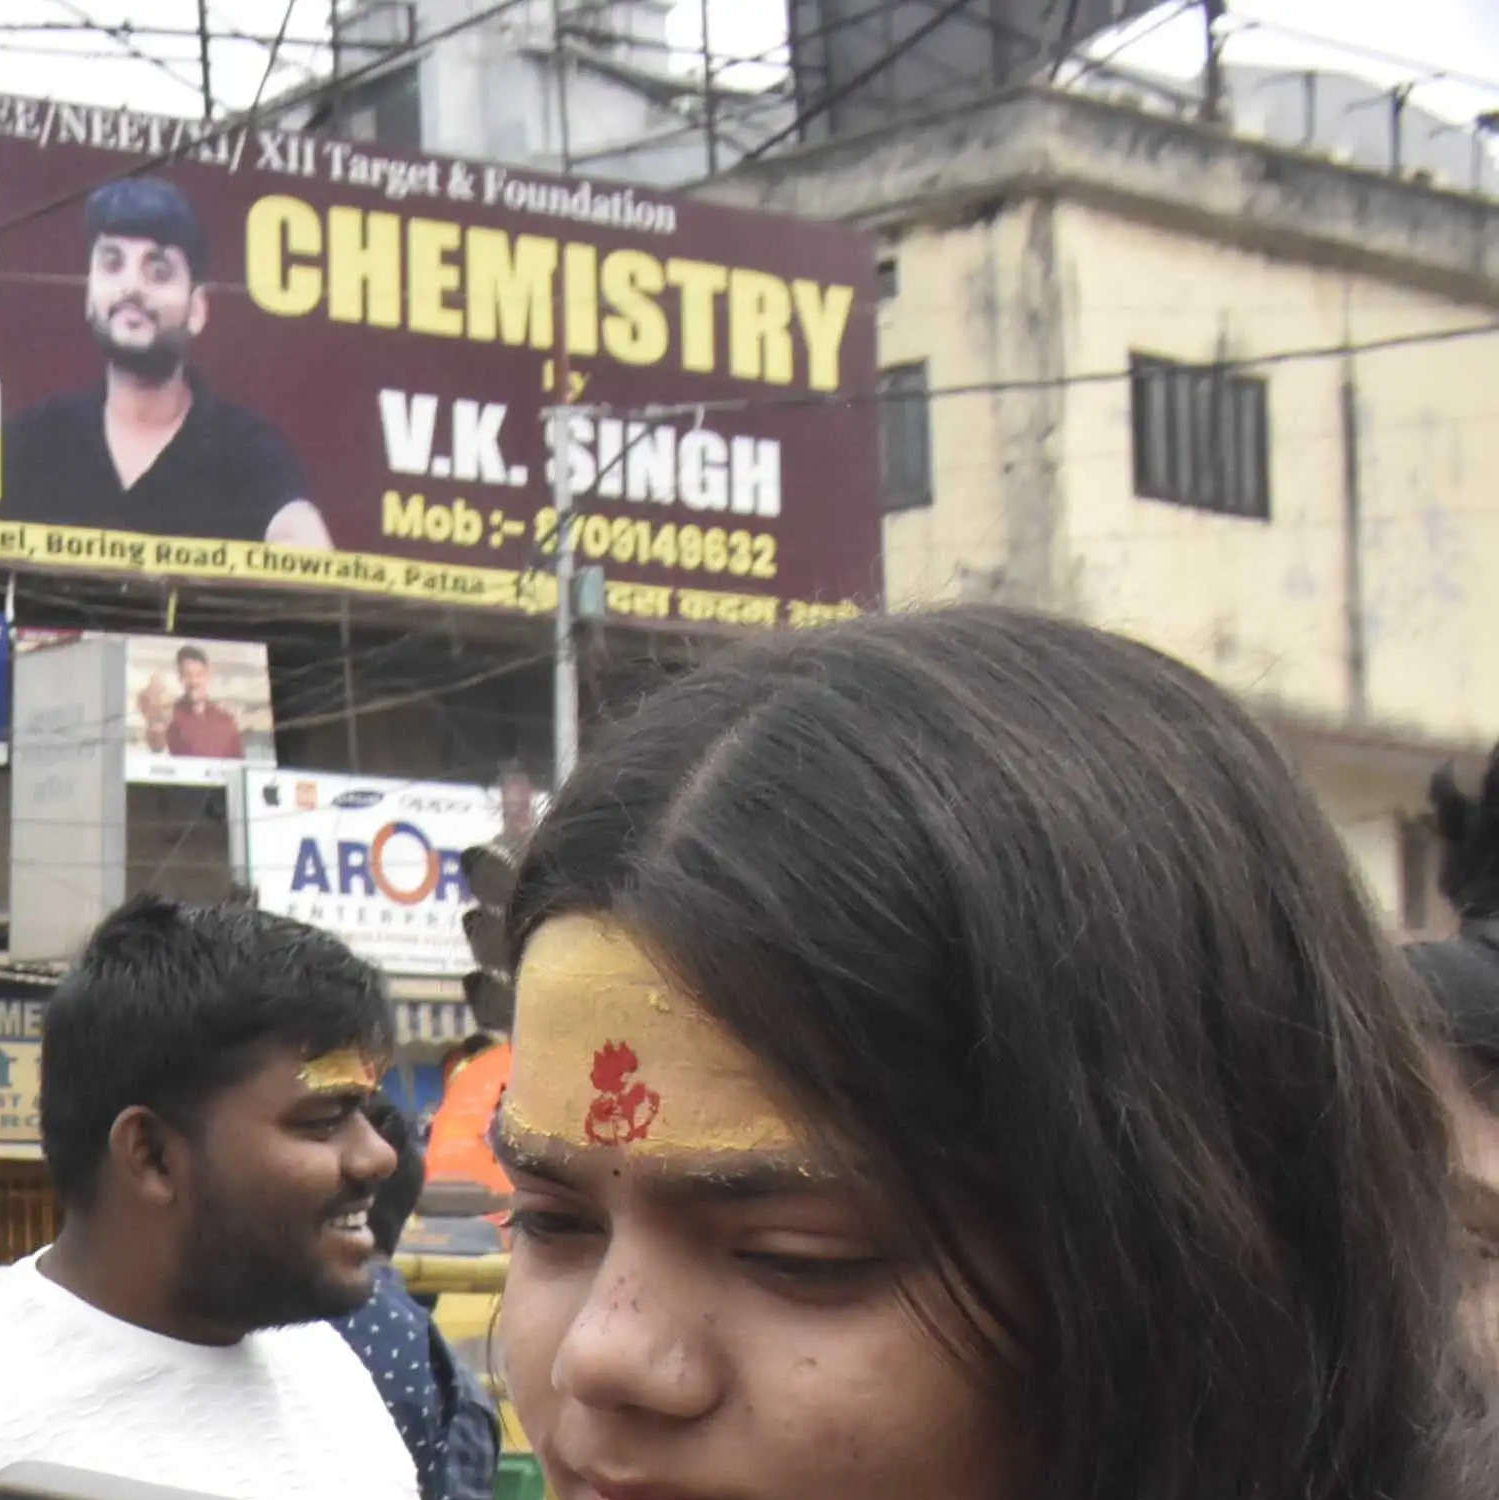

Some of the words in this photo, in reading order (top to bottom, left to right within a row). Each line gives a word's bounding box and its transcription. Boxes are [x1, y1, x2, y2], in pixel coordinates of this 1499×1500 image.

[323, 143, 440, 199] Target
[447, 161, 476, 198] &
[483, 168, 677, 234] Foundation
[245, 194, 853, 393] CHEMISTRY
[378, 389, 528, 487] V.K.
[545, 410, 781, 518] SINGH
[46, 531, 145, 564] Boring
[154, 541, 236, 575] Road,
[245, 545, 395, 588] Chowraha,
[382, 490, 482, 546] Mob
